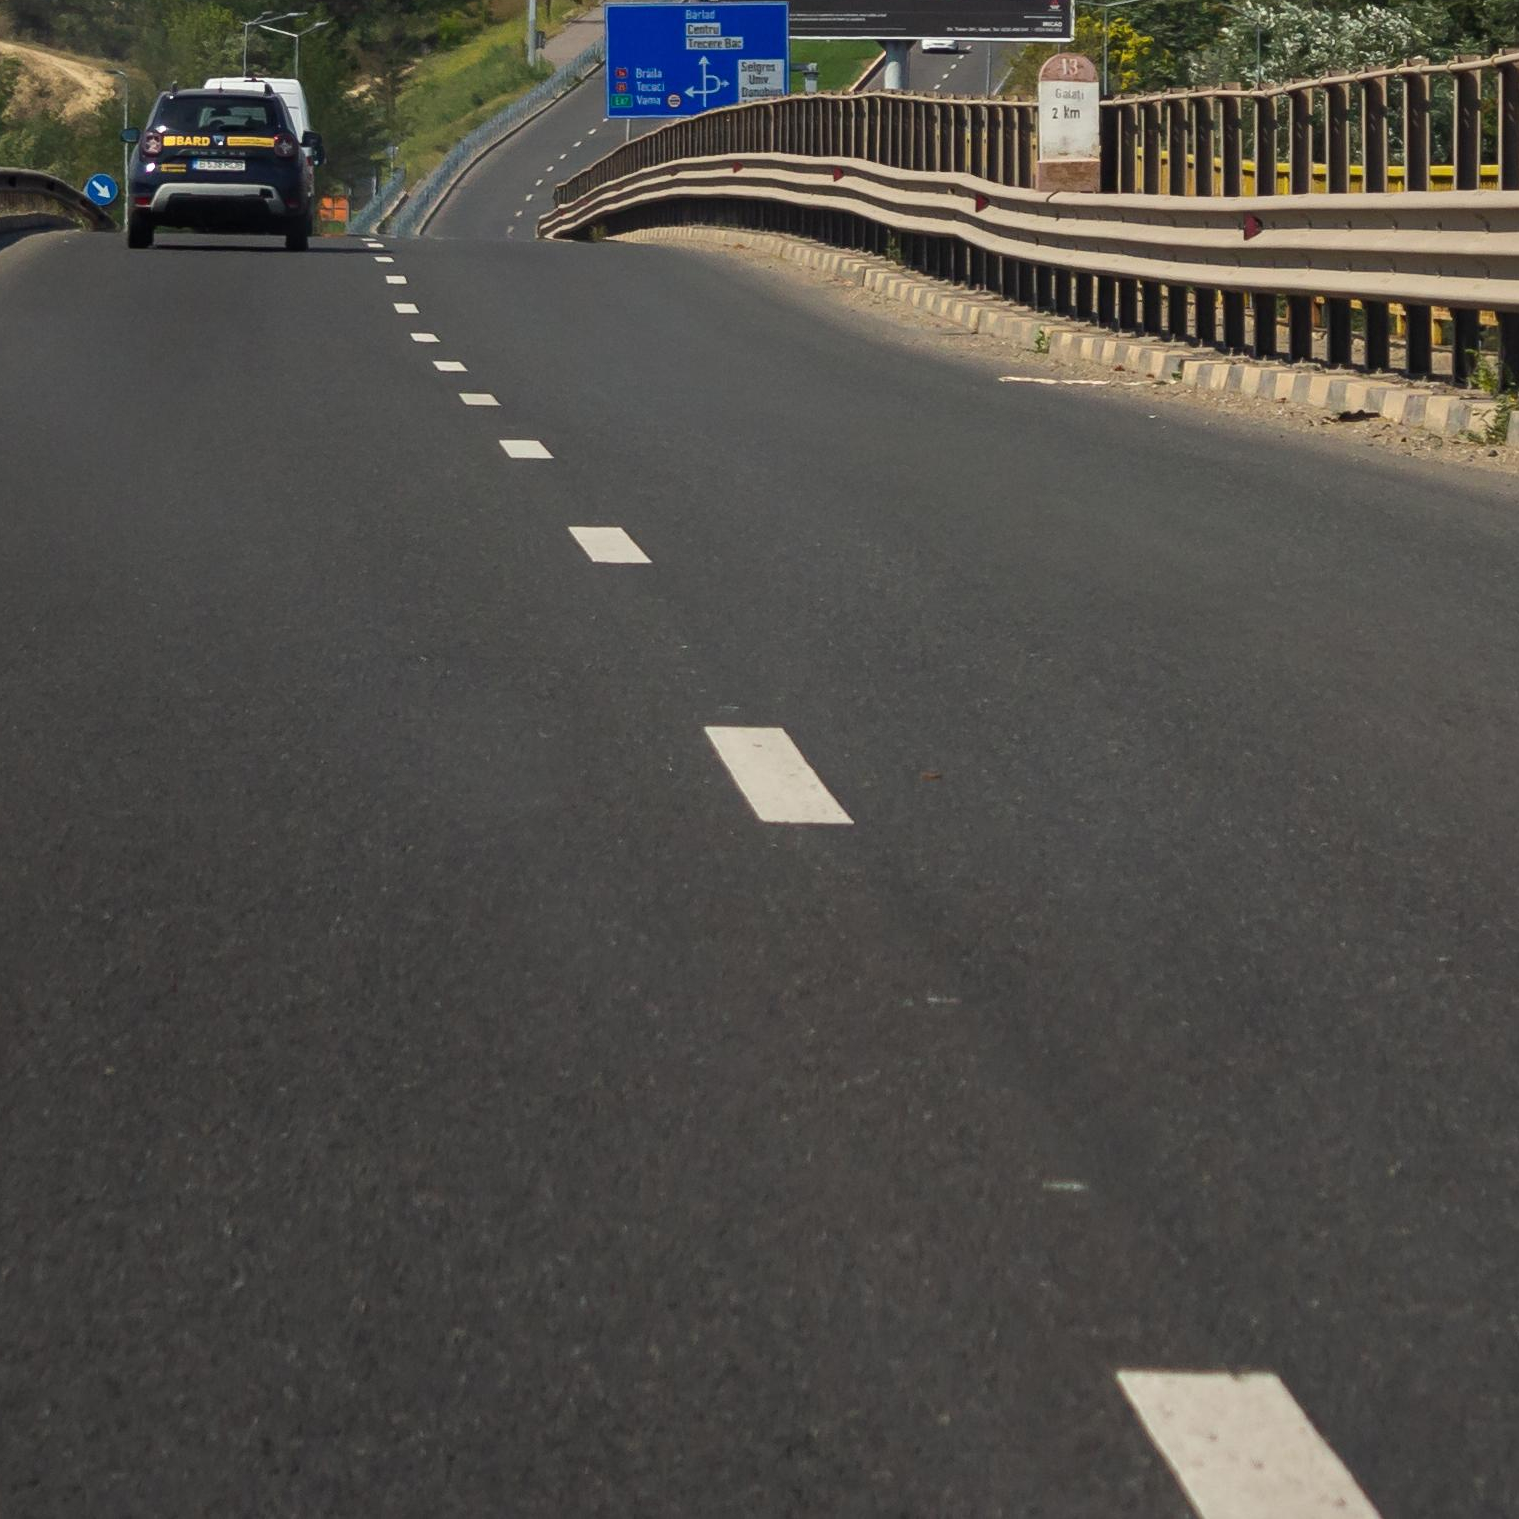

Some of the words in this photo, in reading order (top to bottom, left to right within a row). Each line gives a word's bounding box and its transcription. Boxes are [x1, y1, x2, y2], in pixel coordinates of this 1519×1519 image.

[687, 24, 719, 34] Centru
[688, 38, 722, 49] Trecere
[725, 38, 742, 49] Bac
[1061, 57, 1079, 76] 13
[1051, 107, 1059, 120] 2
[1063, 105, 1081, 119] km
[176, 136, 211, 146] BARD
